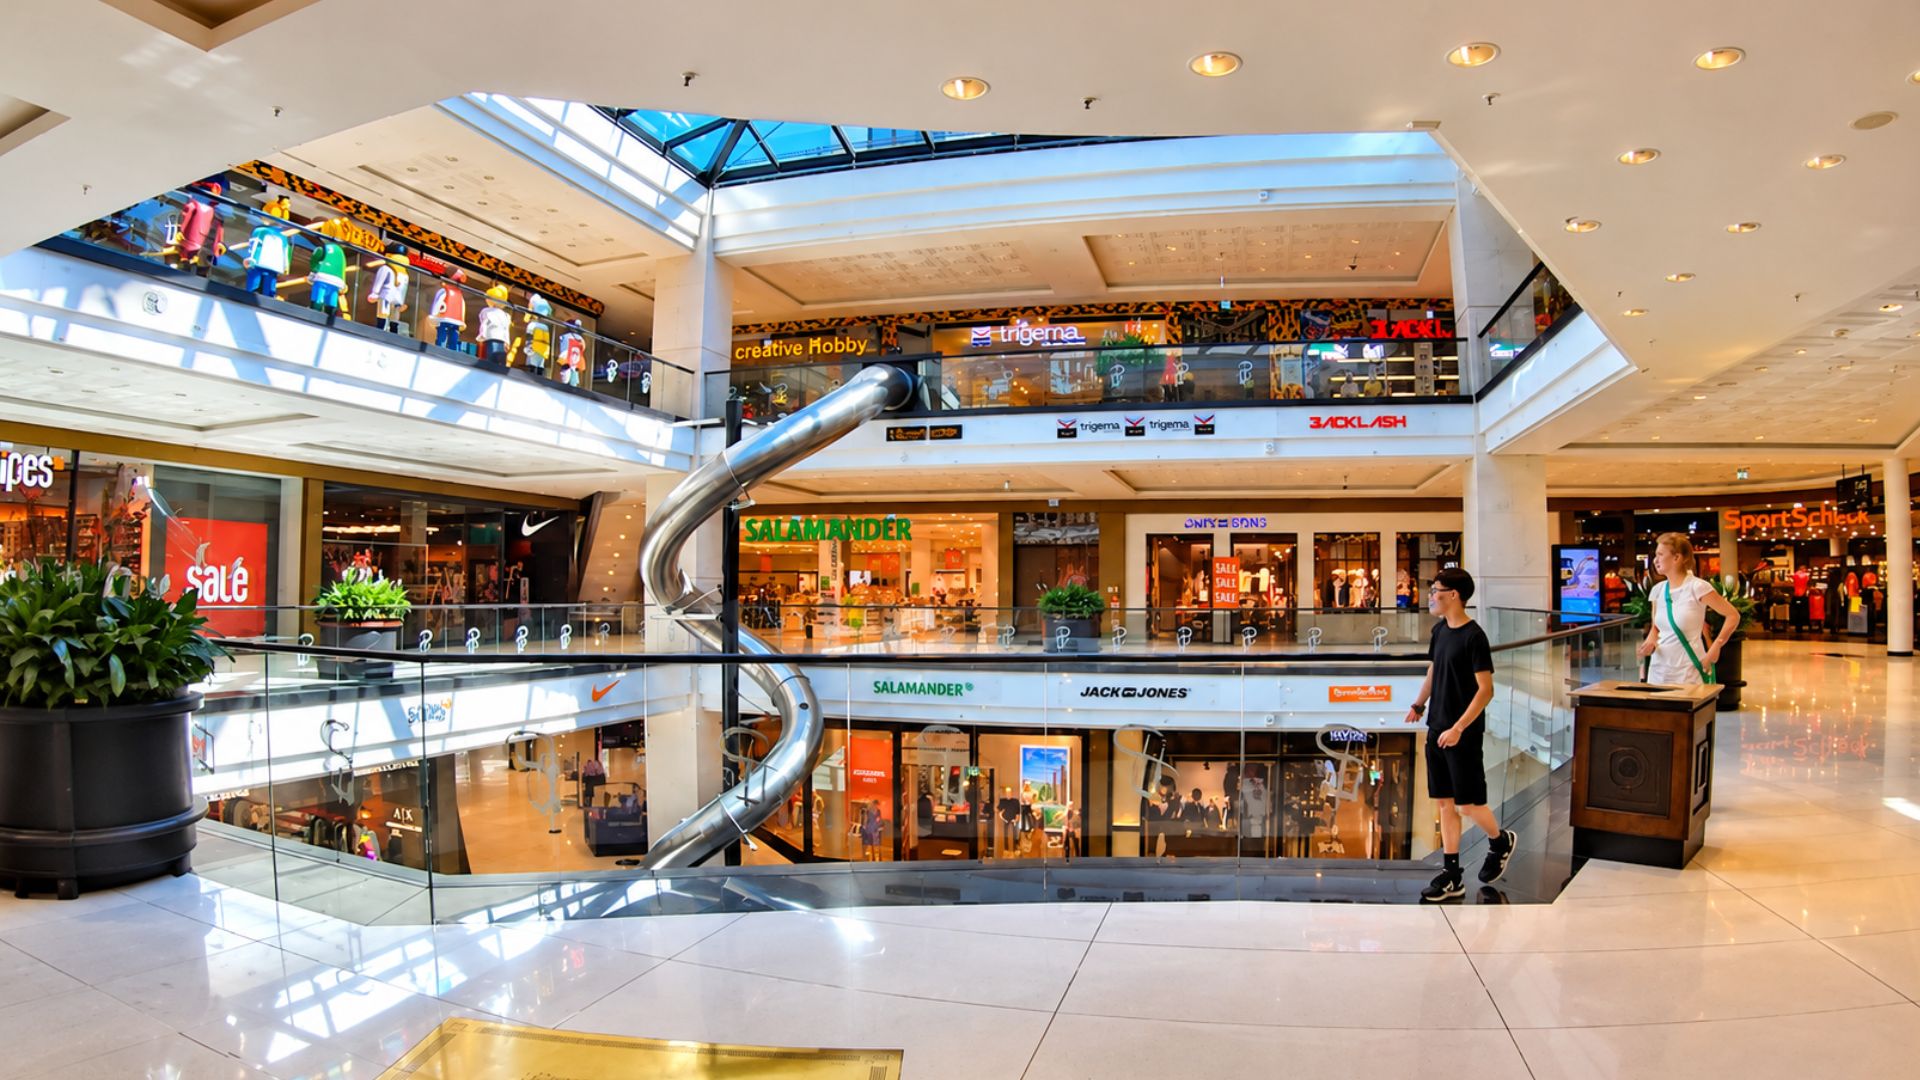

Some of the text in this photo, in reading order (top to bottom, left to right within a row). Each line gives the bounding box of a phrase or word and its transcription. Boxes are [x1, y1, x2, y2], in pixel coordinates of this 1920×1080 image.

[1000, 319, 1080, 346] trigema
[735, 336, 868, 360] creative Hobby
[1080, 421, 1121, 433] trigema
[1149, 419, 1190, 431] trigema
[745, 518, 912, 541] SALAMANDER
[186, 565, 248, 603] sale
[873, 680, 964, 697] SALAMANDER
[1080, 687, 1188, 698] JACK JONES
